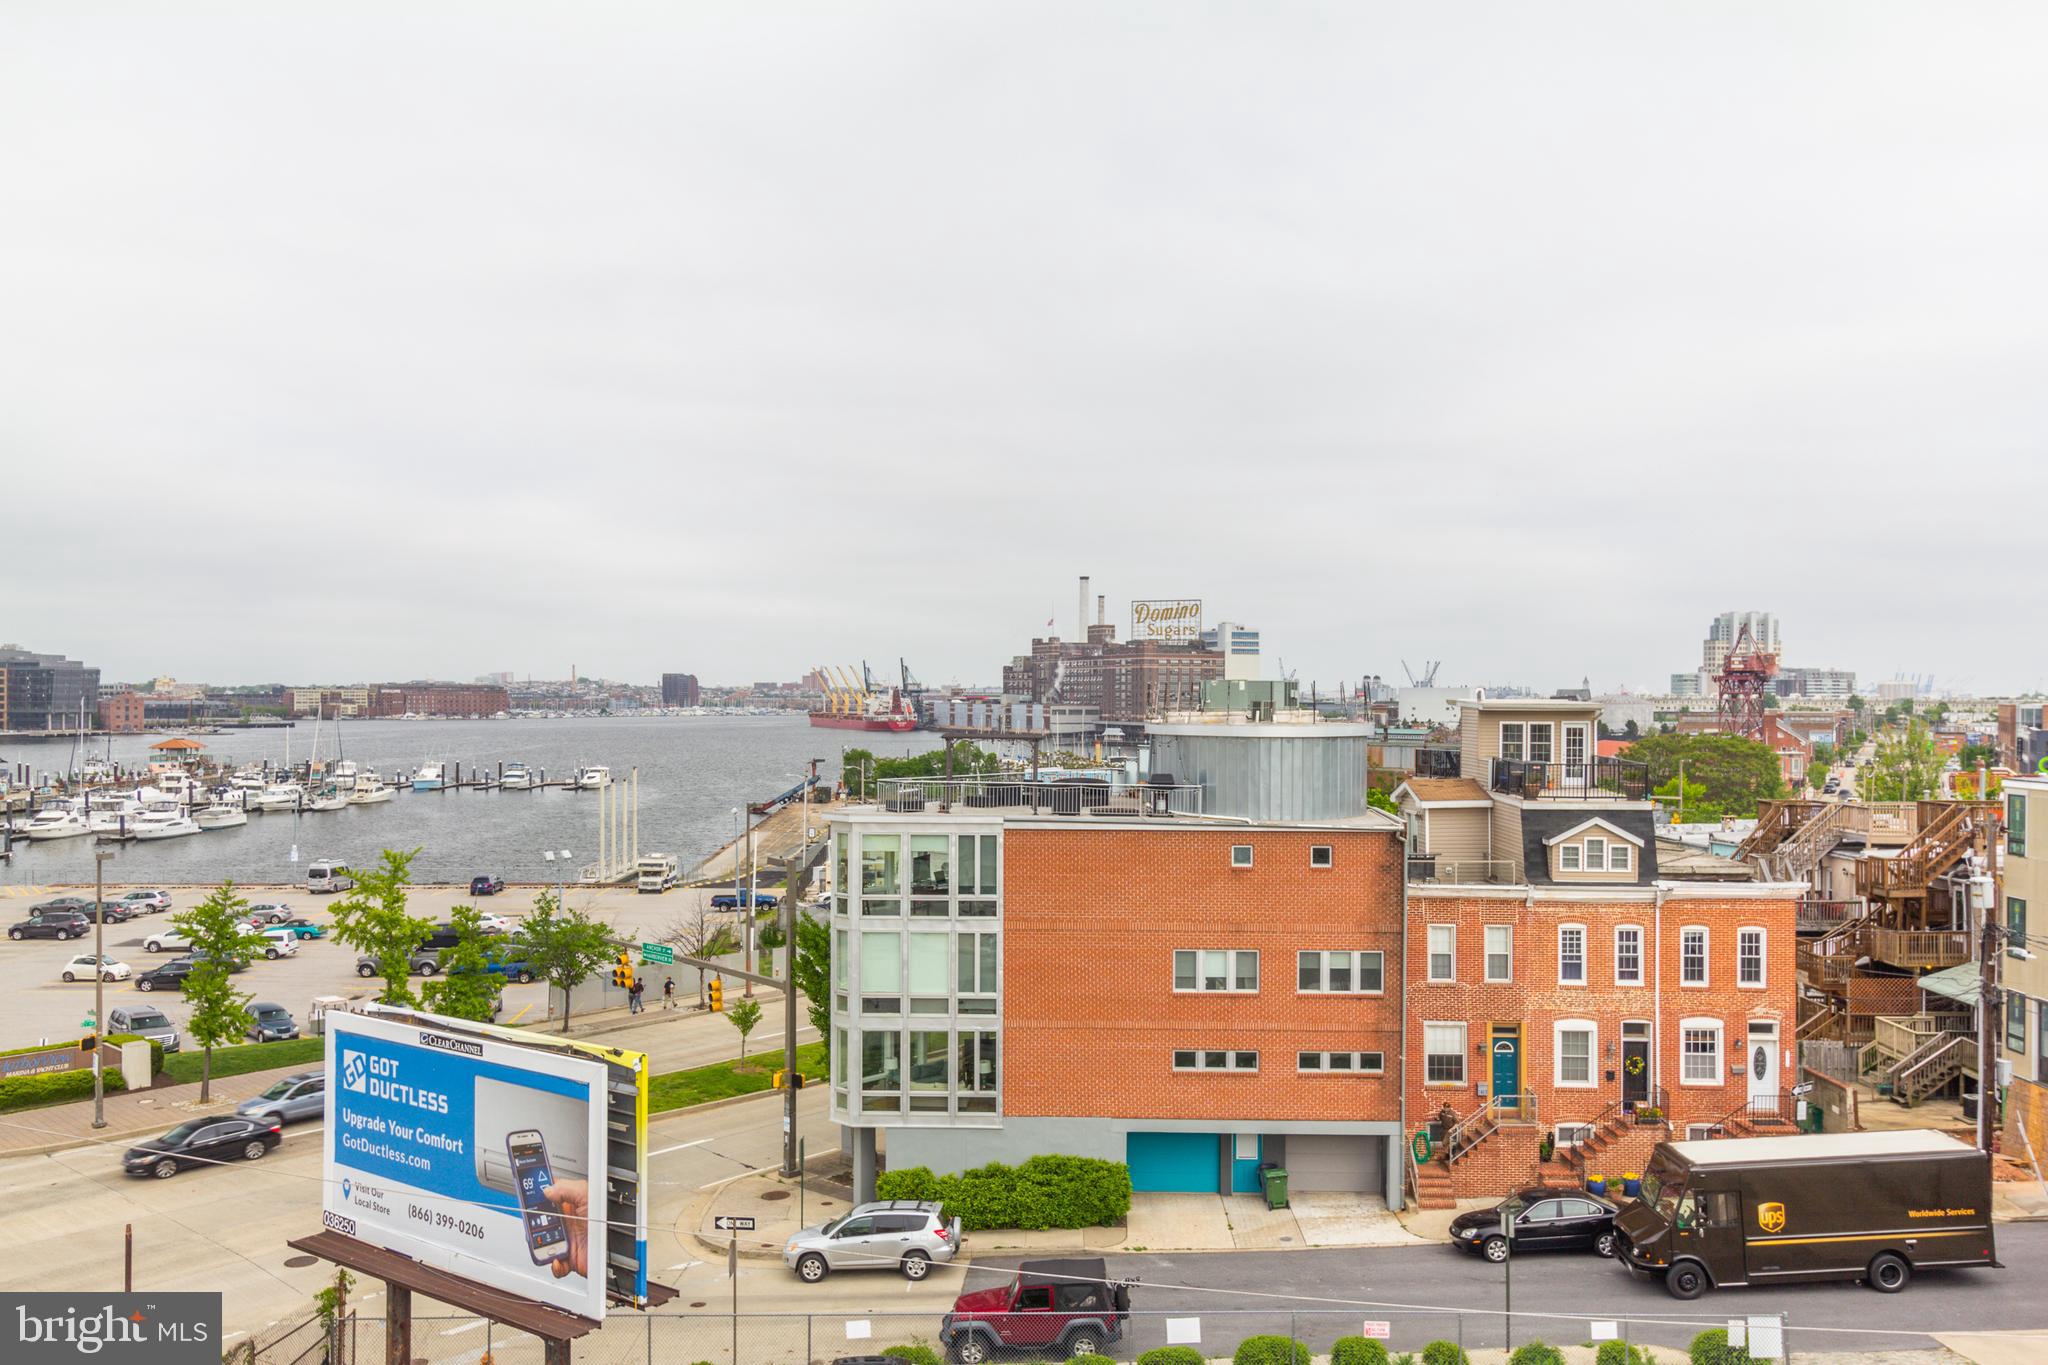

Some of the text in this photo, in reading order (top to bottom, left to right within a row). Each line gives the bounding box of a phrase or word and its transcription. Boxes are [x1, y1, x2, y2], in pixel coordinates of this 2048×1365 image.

[1135, 602, 1199, 624] Domino
[1147, 623, 1196, 641] Sugars
[369, 1055, 399, 1078] GOT
[369, 1077, 449, 1114] DUCTLESS
[342, 1107, 463, 1154] Upgrade Your Comfort
[342, 1133, 431, 1170] GotDuctless.com
[354, 1182, 384, 1199] Visit Our
[354, 1196, 391, 1216] Local Store
[1908, 1208, 1975, 1218] Worldwide Services
[323, 1211, 356, 1236] 036250
[408, 1203, 484, 1239] (866) 399-0206
[1761, 1211, 1783, 1228] ups
